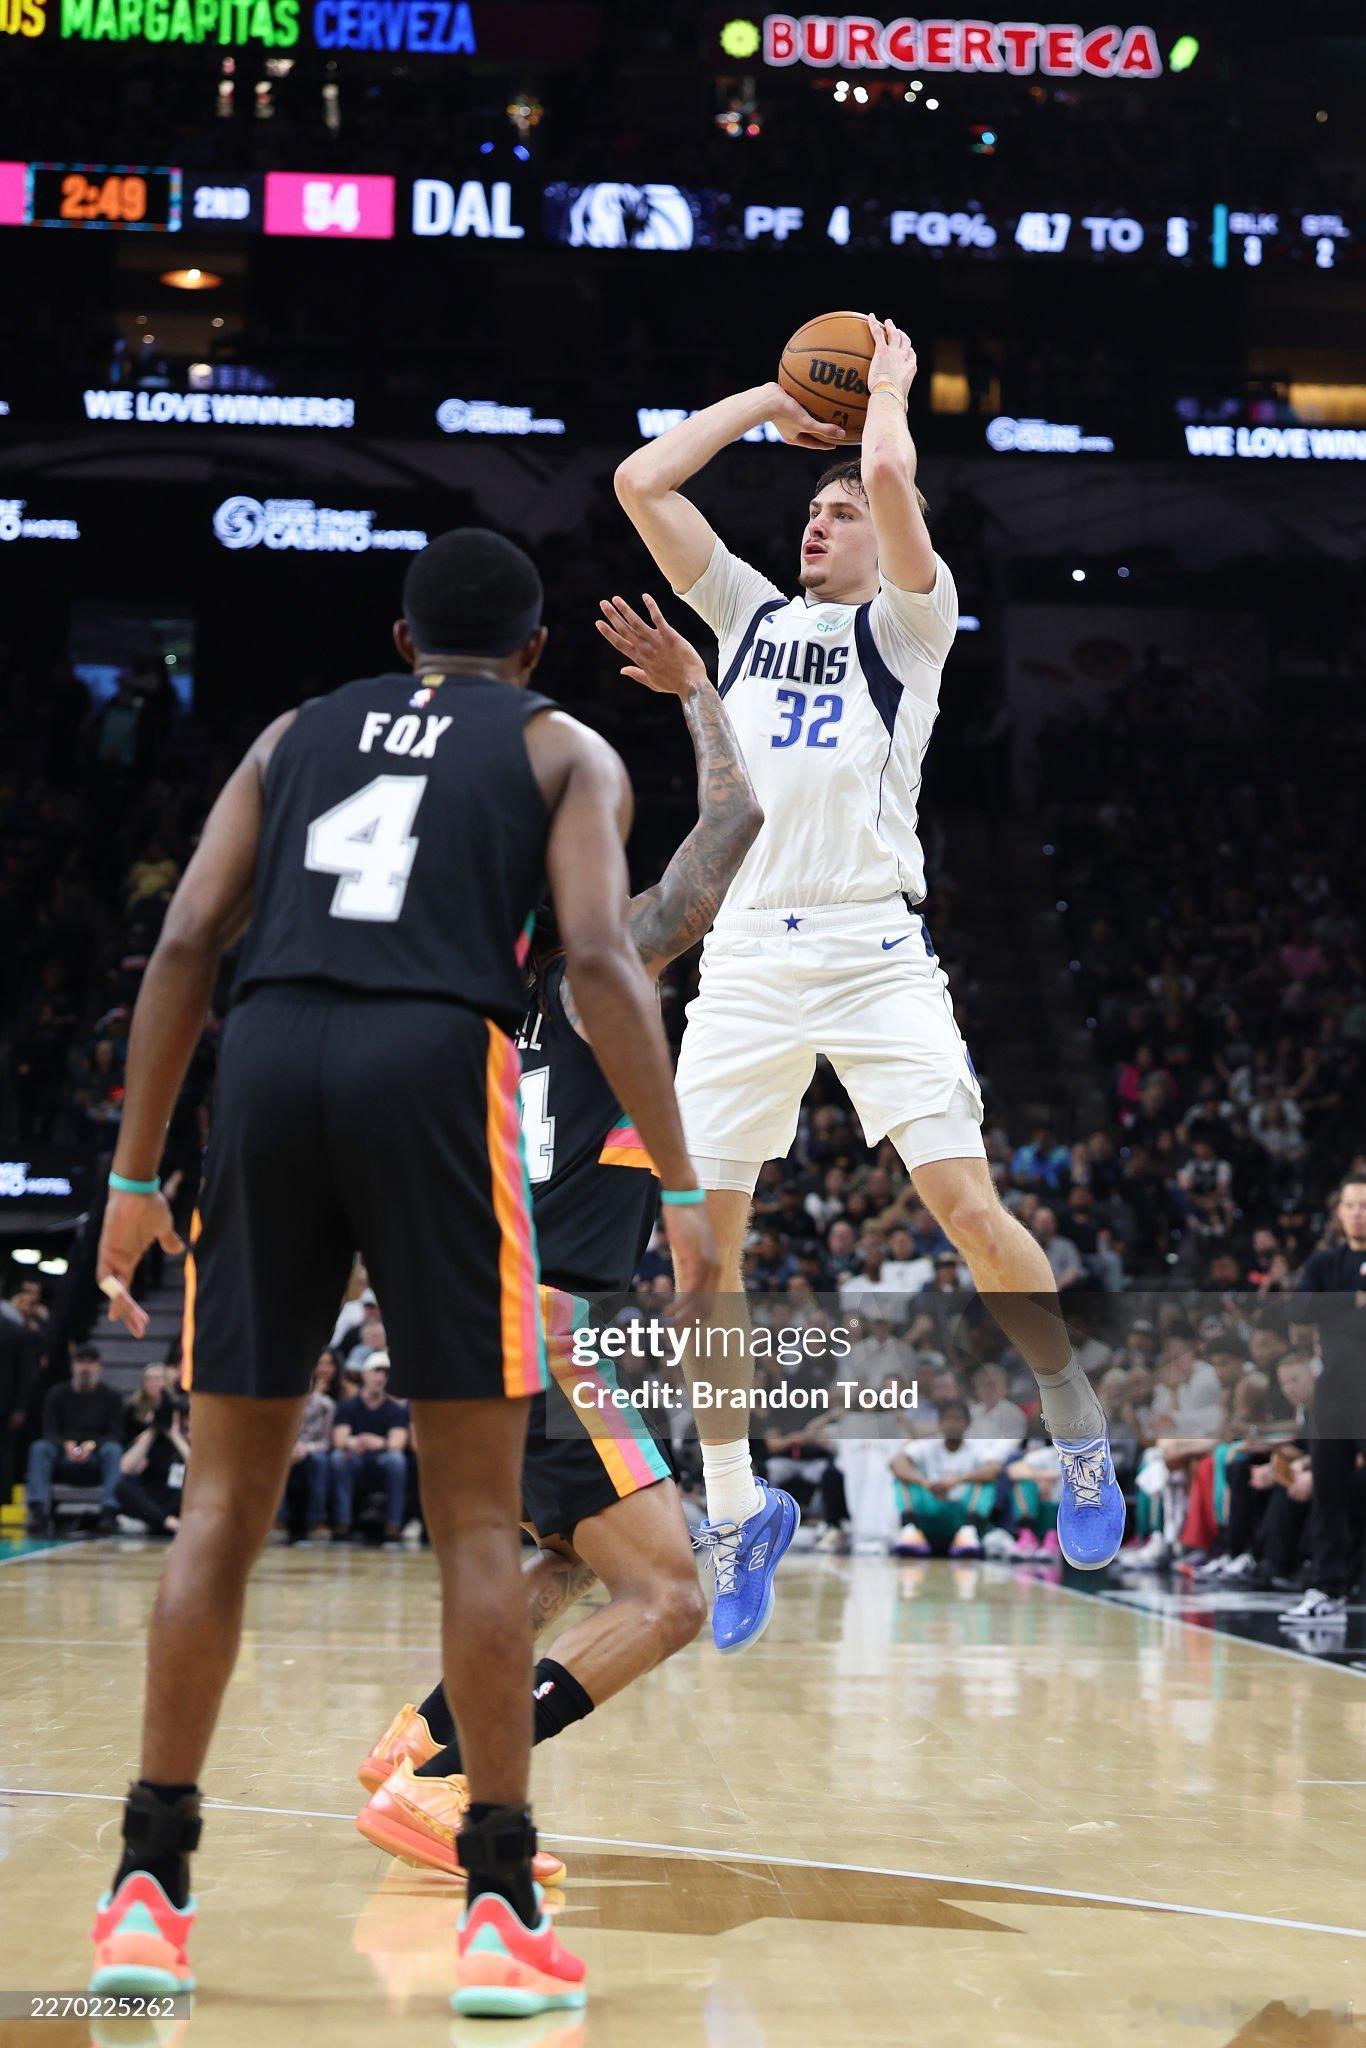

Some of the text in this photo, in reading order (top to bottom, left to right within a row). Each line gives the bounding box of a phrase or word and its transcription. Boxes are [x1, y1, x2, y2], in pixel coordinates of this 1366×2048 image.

[61, 0, 299, 46] MARGARITAS
[313, 0, 476, 53] CERVEZA
[766, 16, 1161, 76] BURGERTECA
[60, 174, 147, 221] 2:49
[303, 181, 360, 232] 54
[412, 178, 525, 238] DAL
[744, 205, 803, 240] PF
[890, 210, 997, 248] FG%
[1081, 217, 1144, 253] TO
[809, 358, 869, 395] Wils
[83, 390, 355, 428] WE LOVE WINNERS!
[1184, 425, 1235, 457] WE
[1236, 426, 1310, 458] LOVE
[747, 638, 849, 685] ALLAS
[358, 711, 454, 758] FOX
[769, 688, 844, 749] 32
[304, 774, 428, 922] 4
